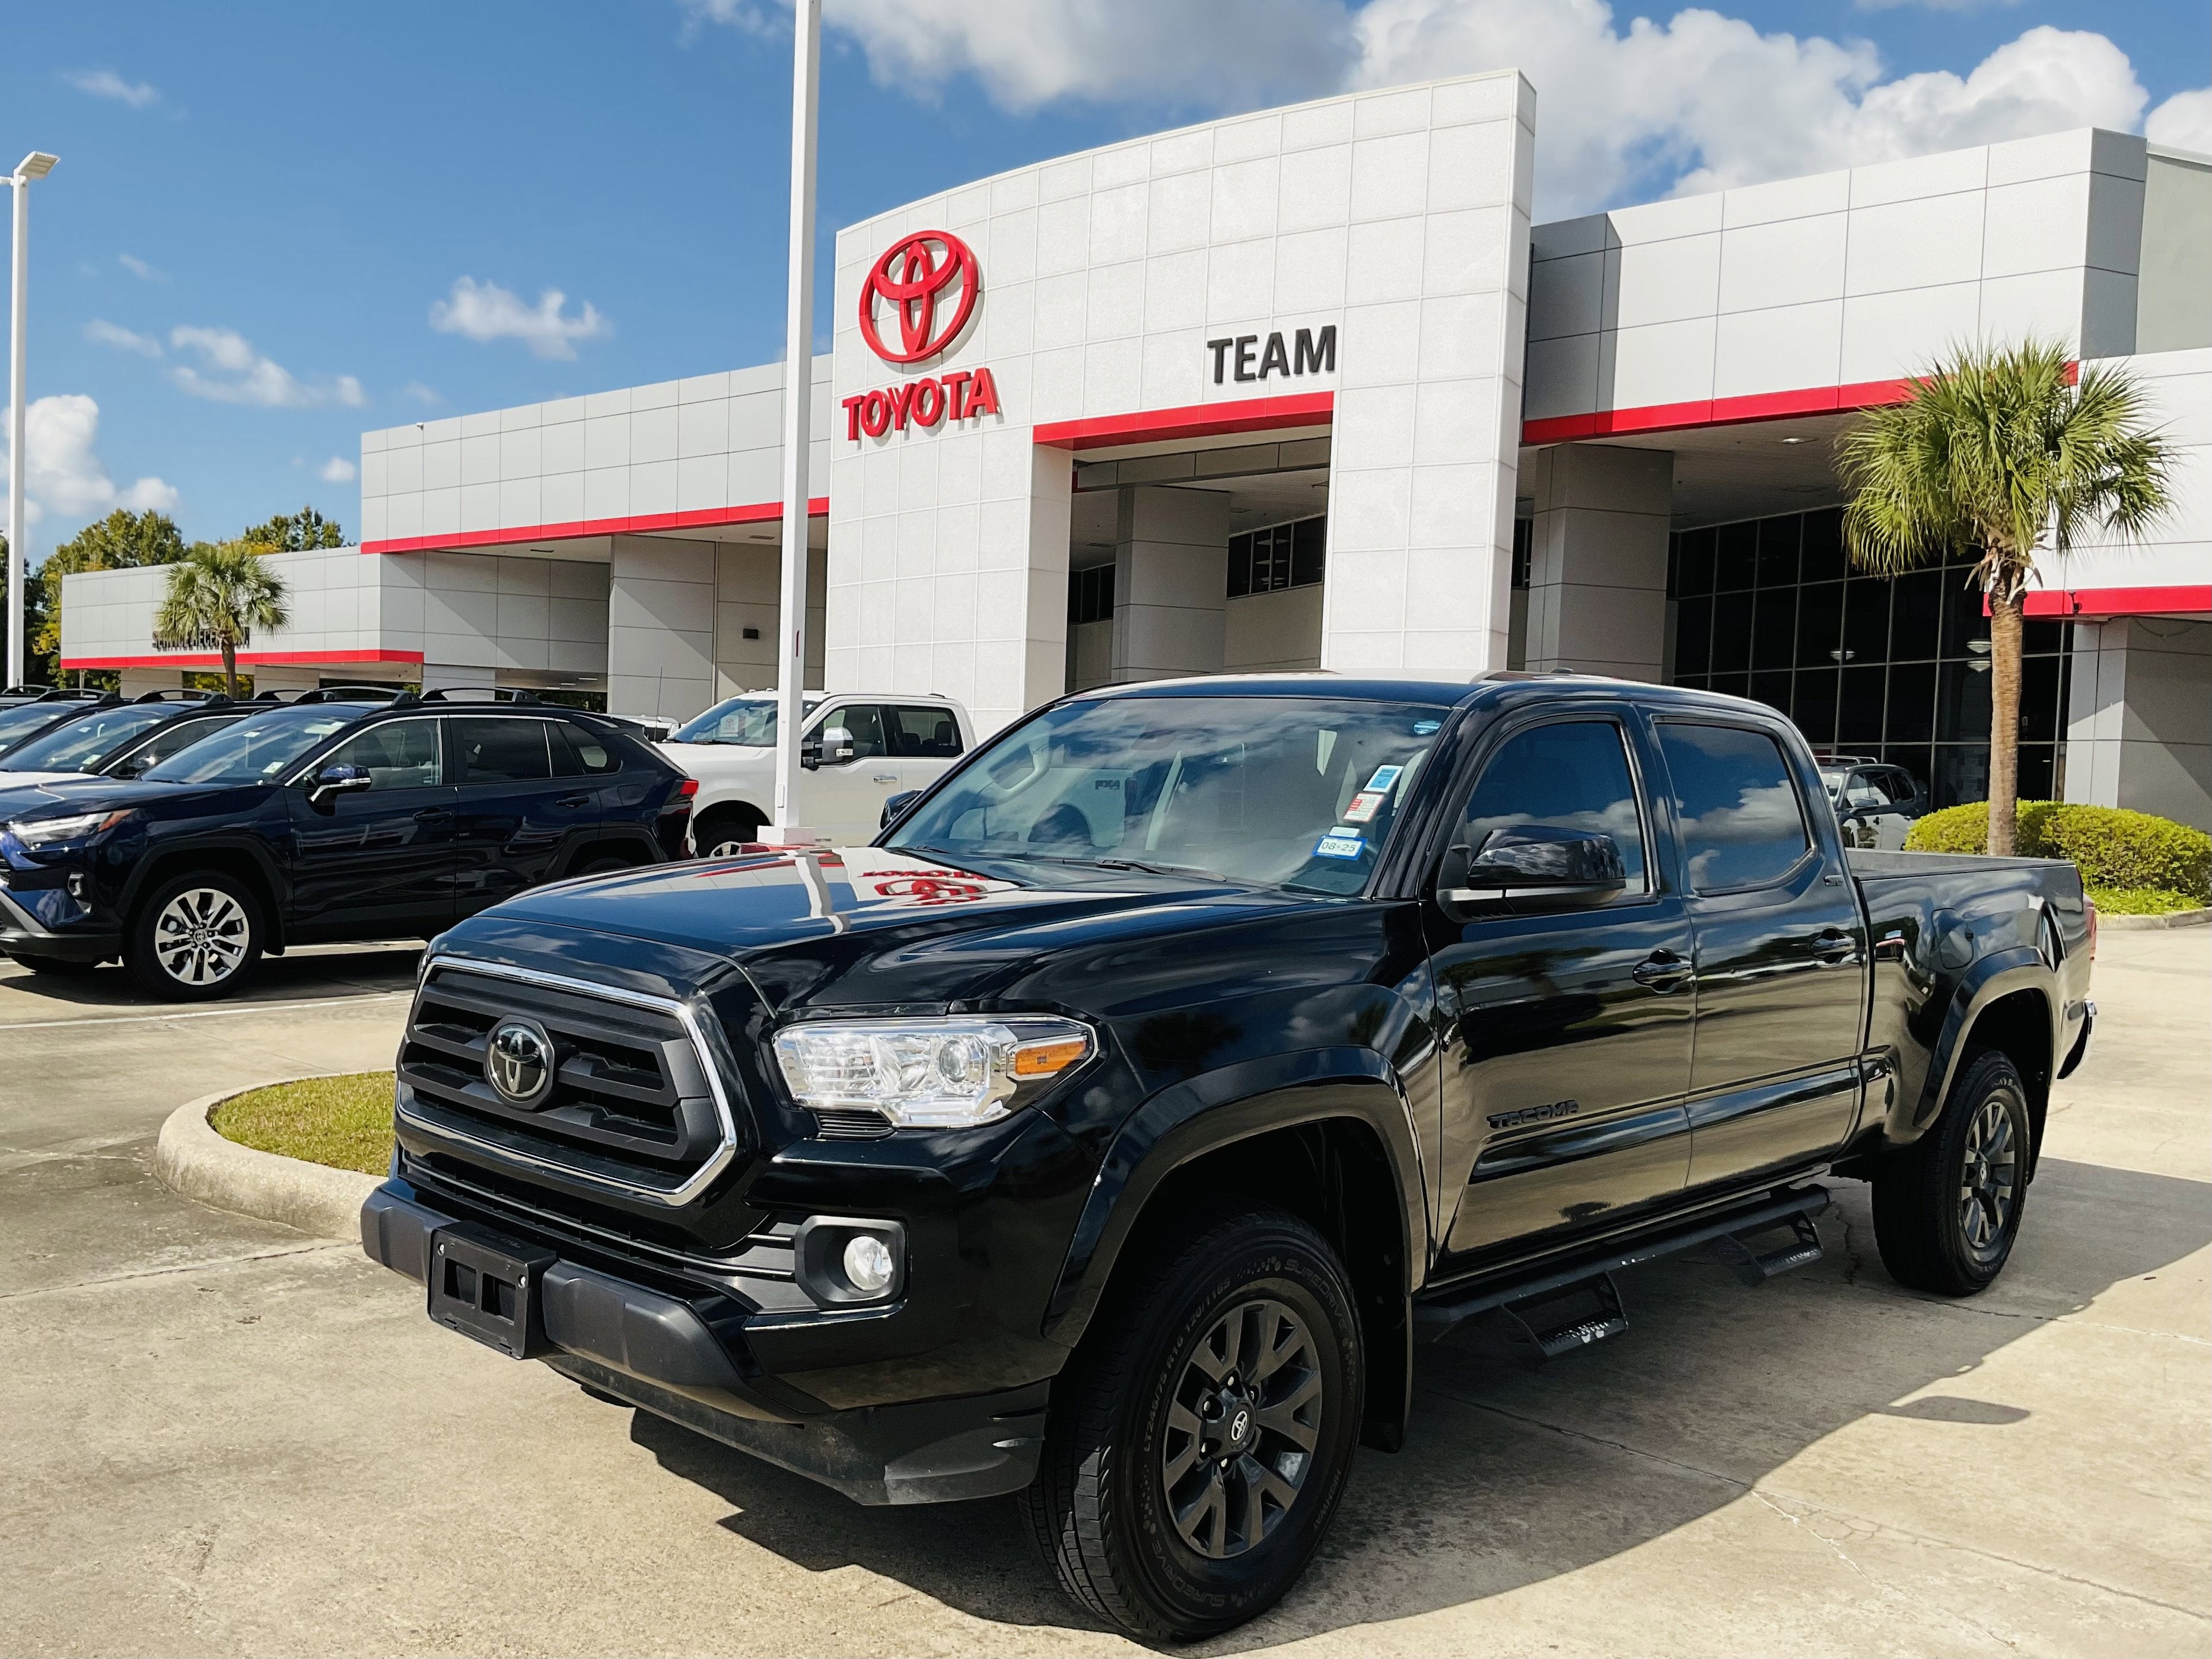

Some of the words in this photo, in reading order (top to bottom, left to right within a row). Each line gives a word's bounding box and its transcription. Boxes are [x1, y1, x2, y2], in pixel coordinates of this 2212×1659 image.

[1207, 325, 1336, 384] TEAM
[842, 367, 1000, 440] TOYOTA
[1487, 1100, 1579, 1128] TACOMA
